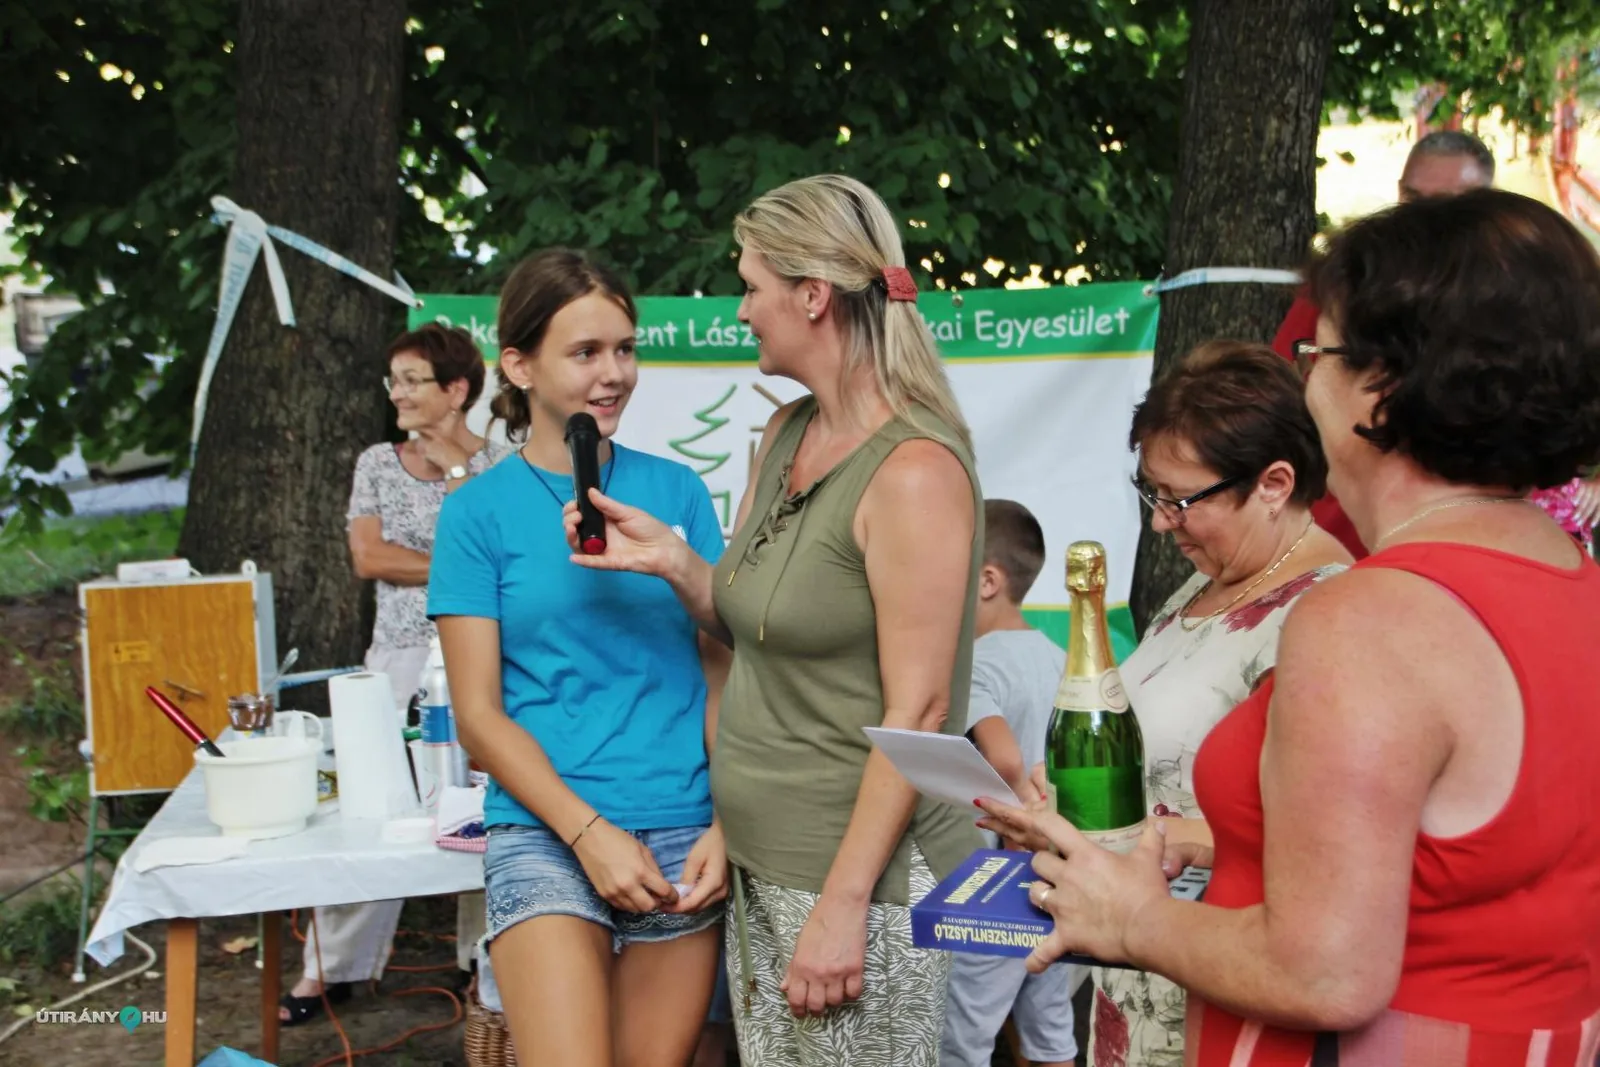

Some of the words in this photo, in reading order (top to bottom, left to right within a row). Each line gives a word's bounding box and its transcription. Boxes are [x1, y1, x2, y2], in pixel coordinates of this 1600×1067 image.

[633, 321, 679, 347] ent
[688, 316, 759, 347] Lász
[919, 312, 963, 341] kai
[974, 306, 1131, 349] Egyesület
[934, 923, 1049, 948] AKONYSZENTLÁSZLÓ
